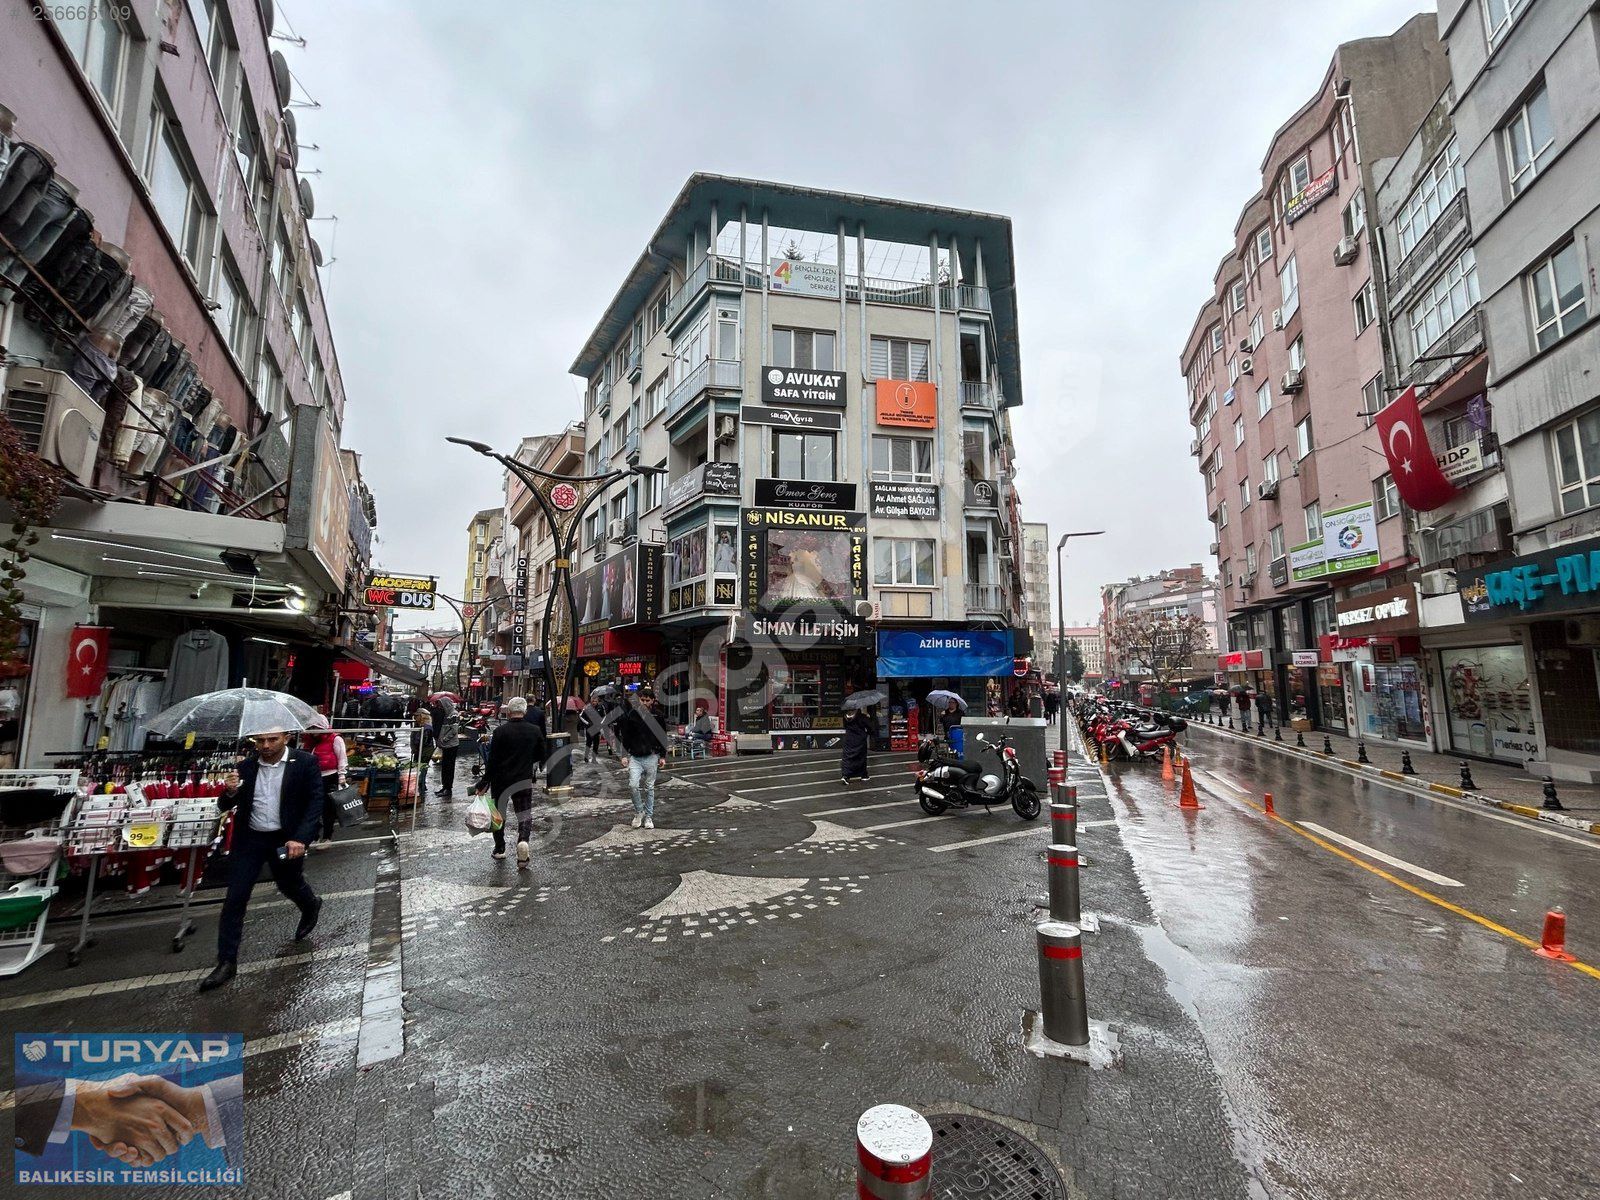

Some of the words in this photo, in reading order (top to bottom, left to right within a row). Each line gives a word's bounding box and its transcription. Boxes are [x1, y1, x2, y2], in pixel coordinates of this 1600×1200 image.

[785, 372, 841, 388] AVUKAT
[773, 388, 799, 399] SAFA
[802, 388, 836, 401] YİTGİN
[1437, 447, 1469, 467] HDP
[775, 482, 806, 497] Ömer
[807, 484, 838, 501] Genç
[875, 494, 885, 503] Av.
[886, 495, 907, 504] Ahmet
[908, 495, 936, 505] SAĞLAM
[765, 511, 847, 526] NİSANUR
[875, 505, 885, 514] Av.
[886, 505, 908, 516] Gülşah
[748, 535, 758, 559] SAÇ
[852, 536, 862, 596] TASARIM
[371, 577, 431, 590] MODERN
[517, 559, 527, 597] OTEL
[368, 590, 395, 605] WC
[401, 592, 432, 608] DUŞ
[1338, 607, 1374, 626] MERKEZ
[1375, 597, 1409, 620] OPTİK
[514, 615, 525, 655] MOLA
[753, 618, 796, 635] SİMAY
[800, 618, 859, 640] İLETİŞİM
[919, 637, 943, 649] AZİM
[945, 638, 971, 649] BÜFE
[772, 716, 792, 729] TEKNİK
[792, 714, 811, 729] SERVİS
[1495, 738, 1523, 751] Merkez
